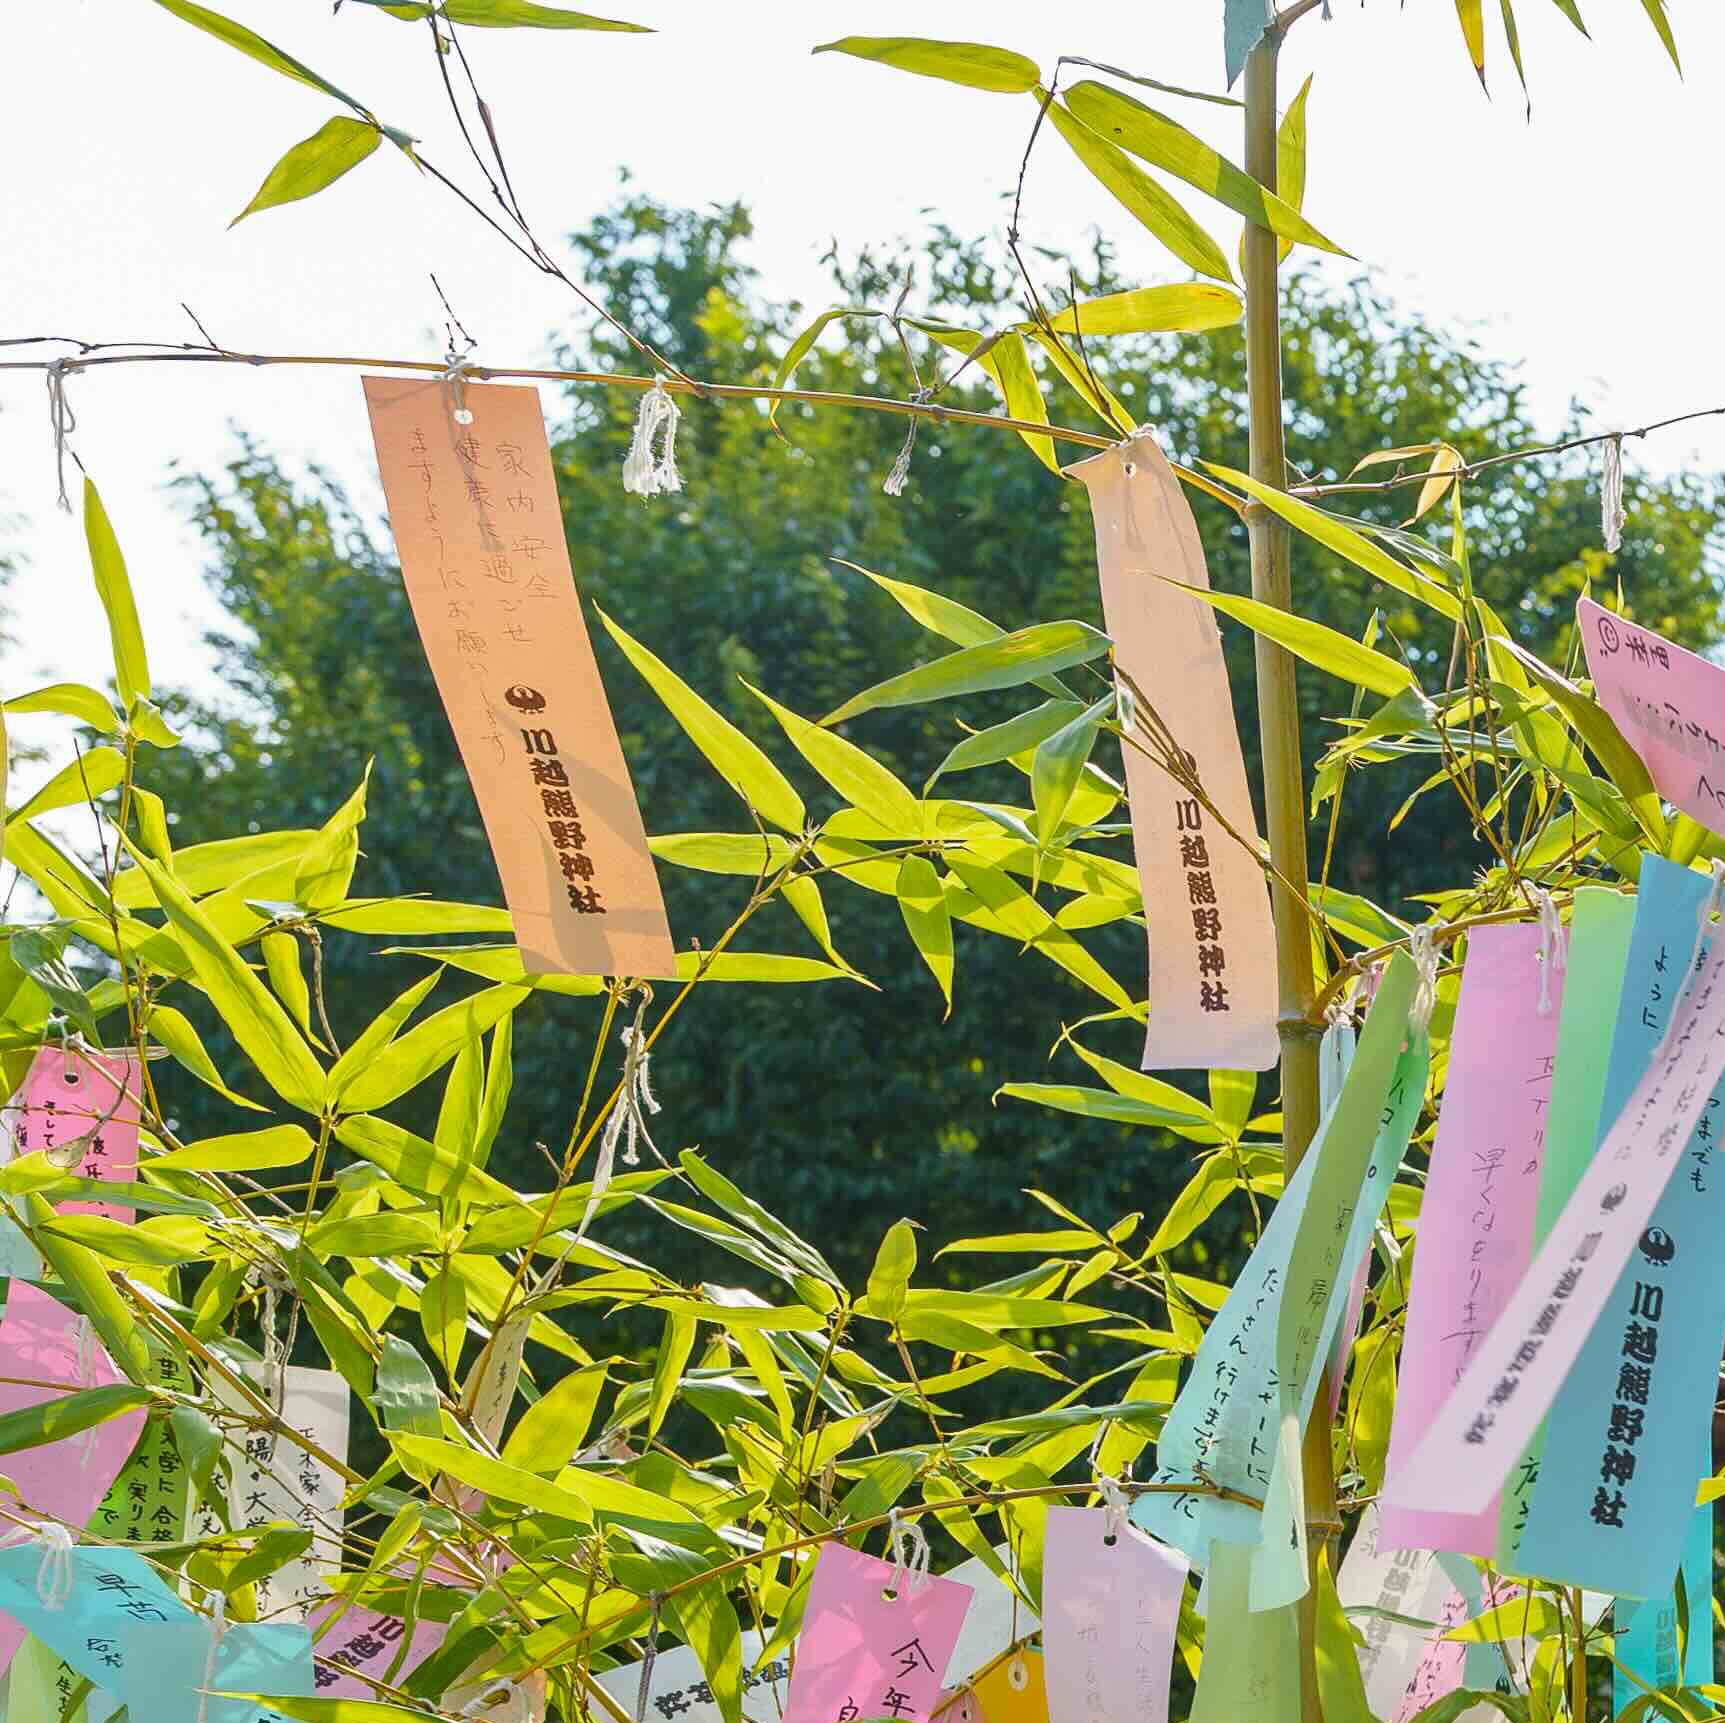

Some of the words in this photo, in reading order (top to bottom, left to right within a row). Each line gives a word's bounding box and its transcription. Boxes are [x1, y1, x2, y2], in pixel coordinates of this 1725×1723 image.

[522, 728, 607, 916] 川越熊野神社
[1175, 798, 1229, 1013] 川越熊野神社
[1590, 1280, 1664, 1529] 川越熊野神社
